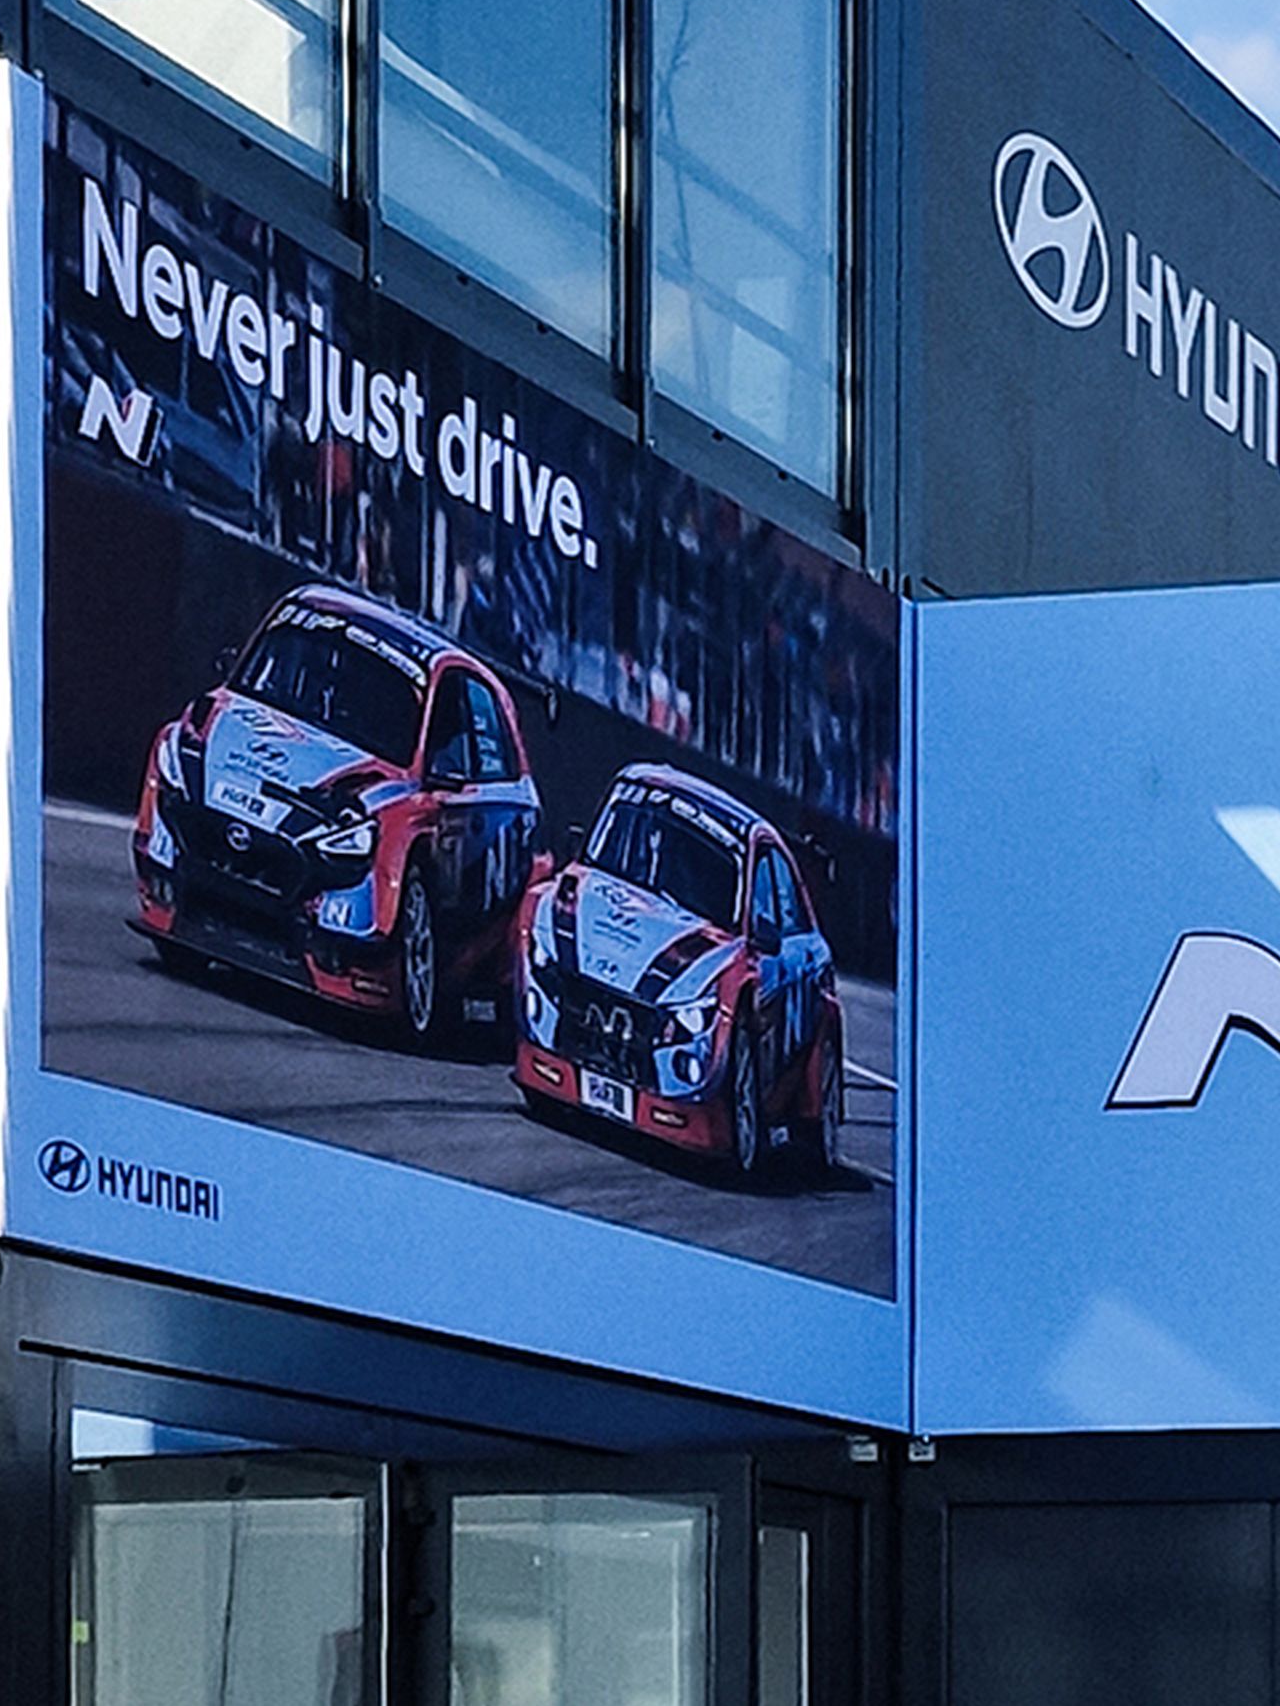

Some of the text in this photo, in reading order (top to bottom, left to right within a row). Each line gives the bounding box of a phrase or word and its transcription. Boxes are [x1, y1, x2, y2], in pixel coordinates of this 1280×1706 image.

[83, 177, 598, 570] Never just drive.
[77, 374, 165, 468] N
[97, 1156, 219, 1223] HYUNDAI
